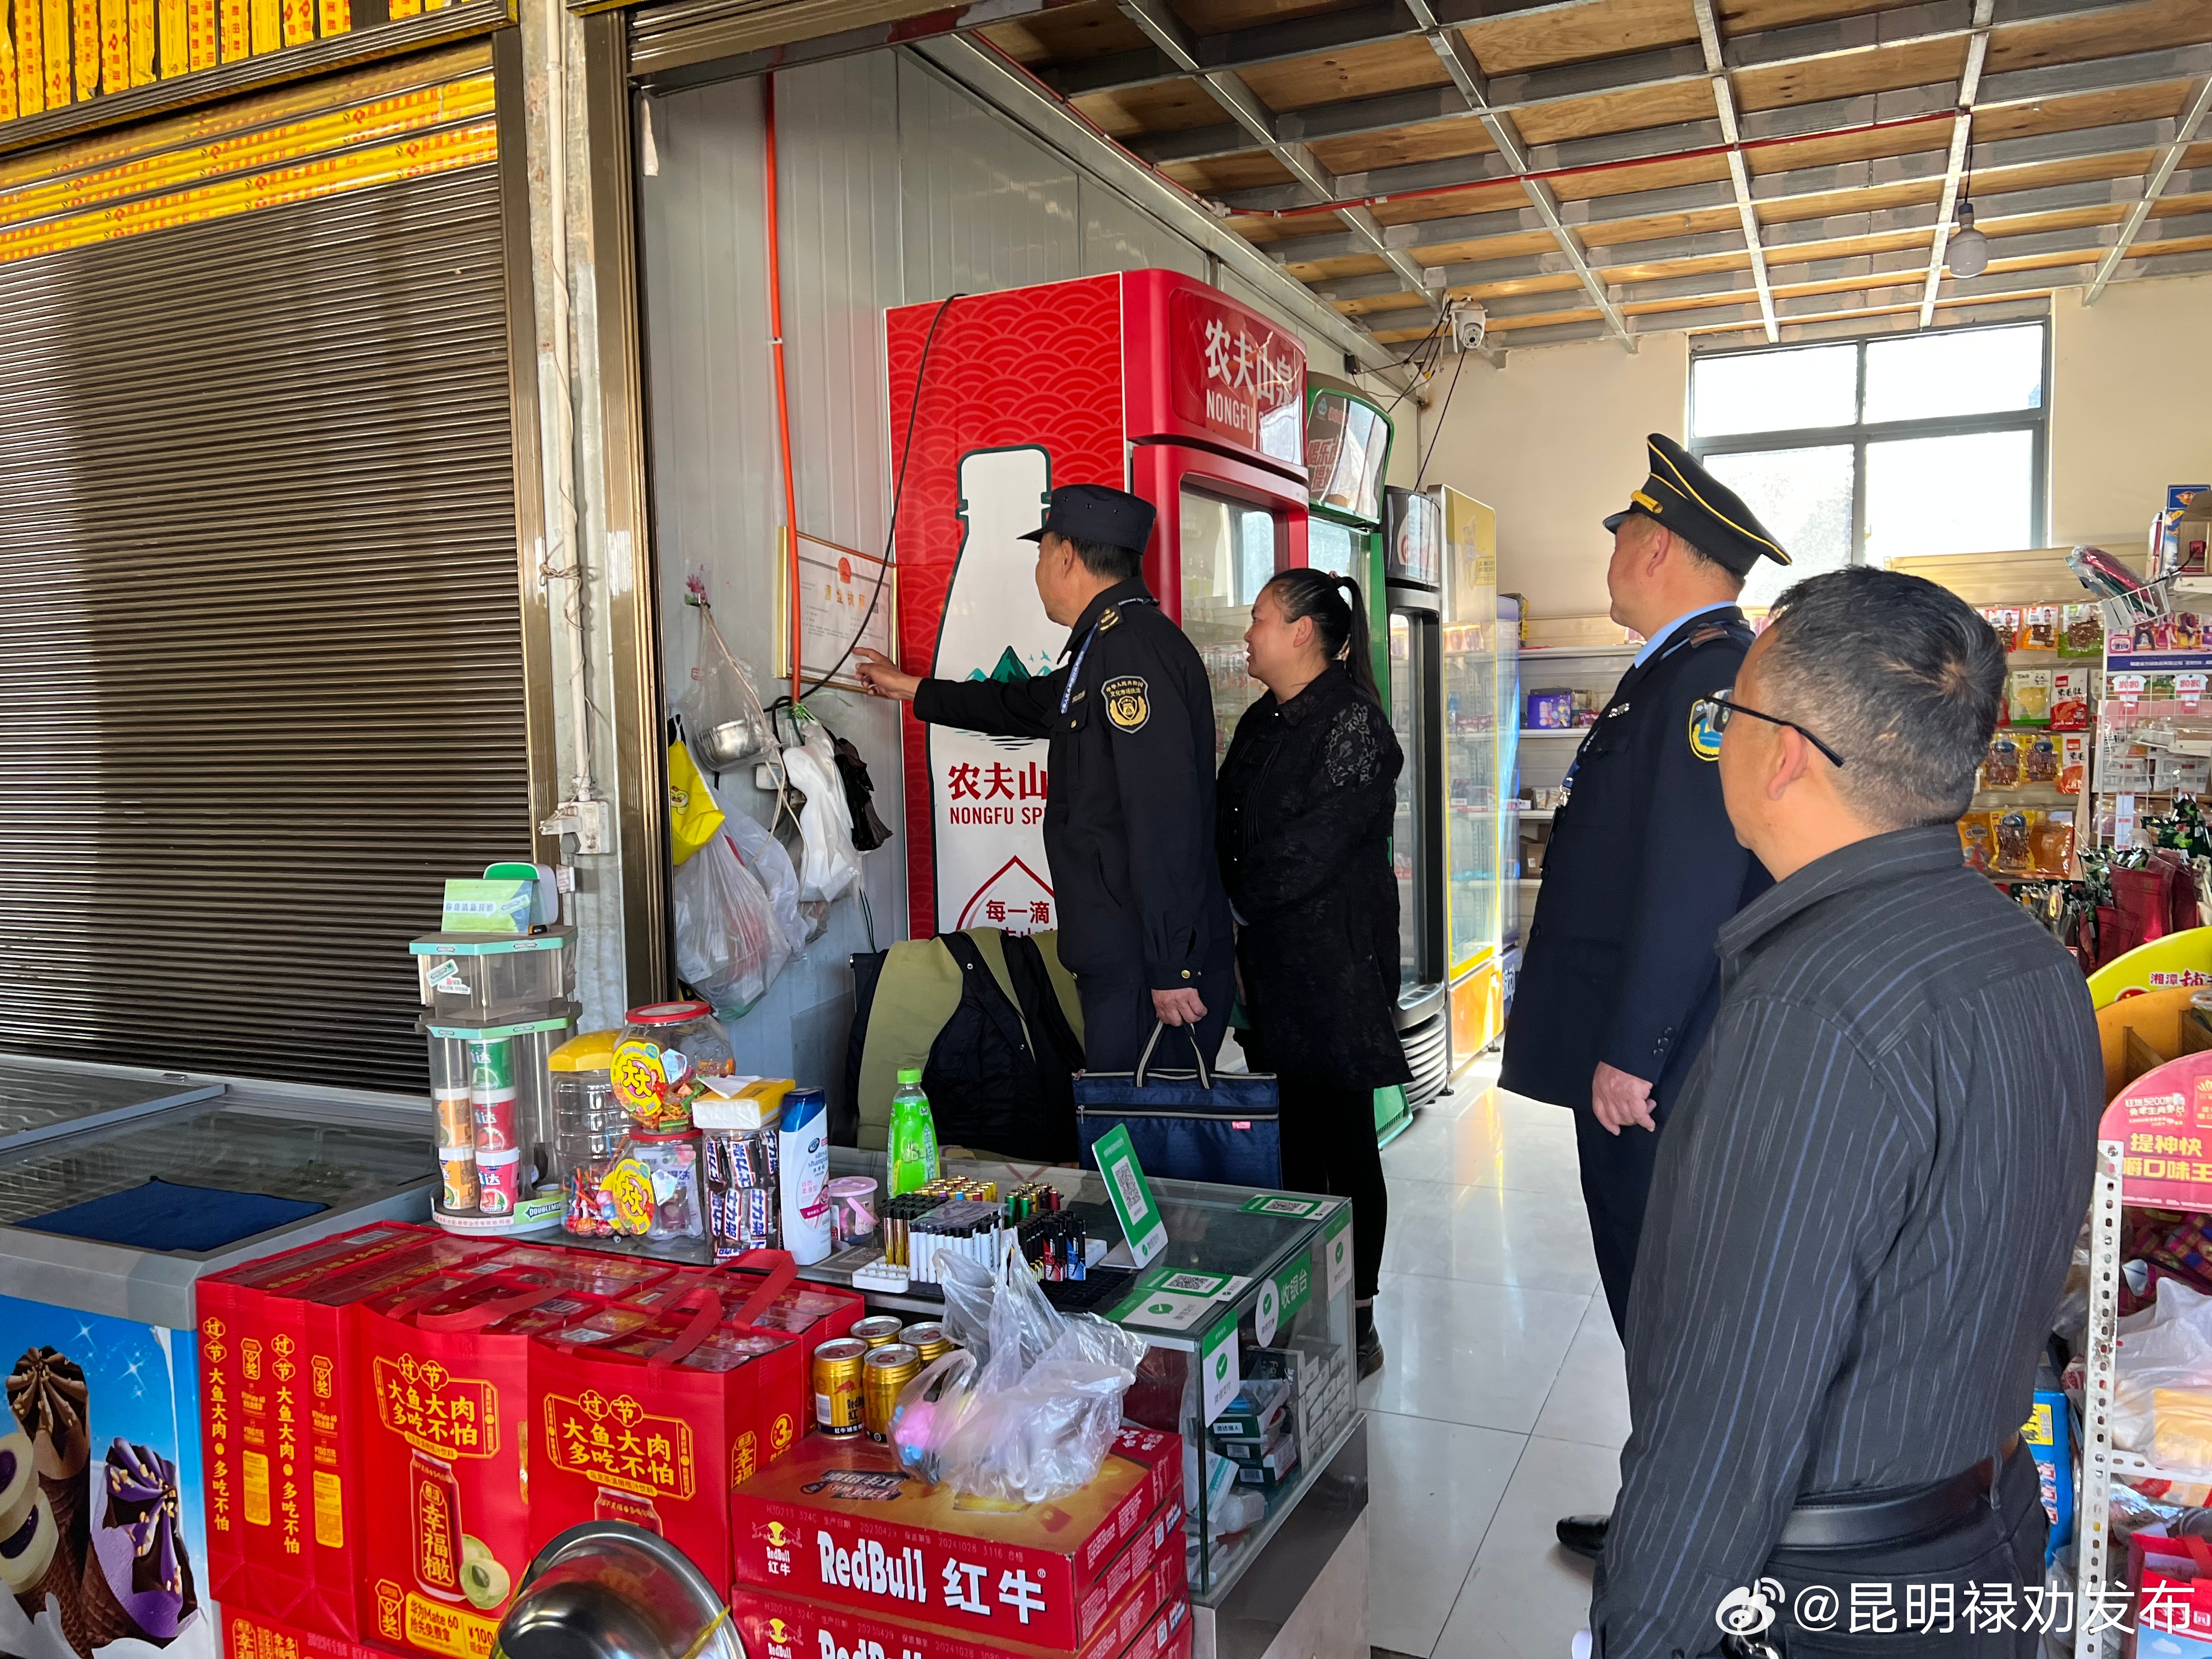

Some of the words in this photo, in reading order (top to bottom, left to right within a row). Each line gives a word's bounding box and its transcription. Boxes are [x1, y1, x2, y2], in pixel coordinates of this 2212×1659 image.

[1205, 318, 1293, 407] 农夫山泉
[1207, 389, 1254, 433] NONGFU
[948, 761, 1047, 800] 农夫山
[950, 807, 1013, 825] NONGFU
[1022, 807, 1046, 825] SP
[986, 899, 1049, 924] 每一滴
[2130, 1132, 2202, 1157] 提神快
[1281, 1268, 1307, 1309] 收银台
[401, 1358, 443, 1388] 过节
[208, 1368, 228, 1439] 大鱼大肉
[276, 1386, 296, 1460] 大鱼大肉
[387, 1379, 475, 1423] 大鱼大肉
[583, 1395, 637, 1424] 过节
[392, 1402, 478, 1447] 多吃不怕
[562, 1417, 671, 1462] 大鱼大肉
[568, 1441, 675, 1486] 多吃不怕
[212, 1460, 229, 1532] 多吃不怕
[281, 1481, 300, 1554] 多吃不怕
[422, 1502, 452, 1583] 幸福橄
[766, 1546, 790, 1563] RedBull
[768, 1560, 791, 1576] 红牛
[817, 1530, 927, 1603] RedBull
[941, 1557, 1047, 1624] 红牛
[382, 1615, 398, 1637] 奖
[768, 1642, 792, 1659] RedBull
